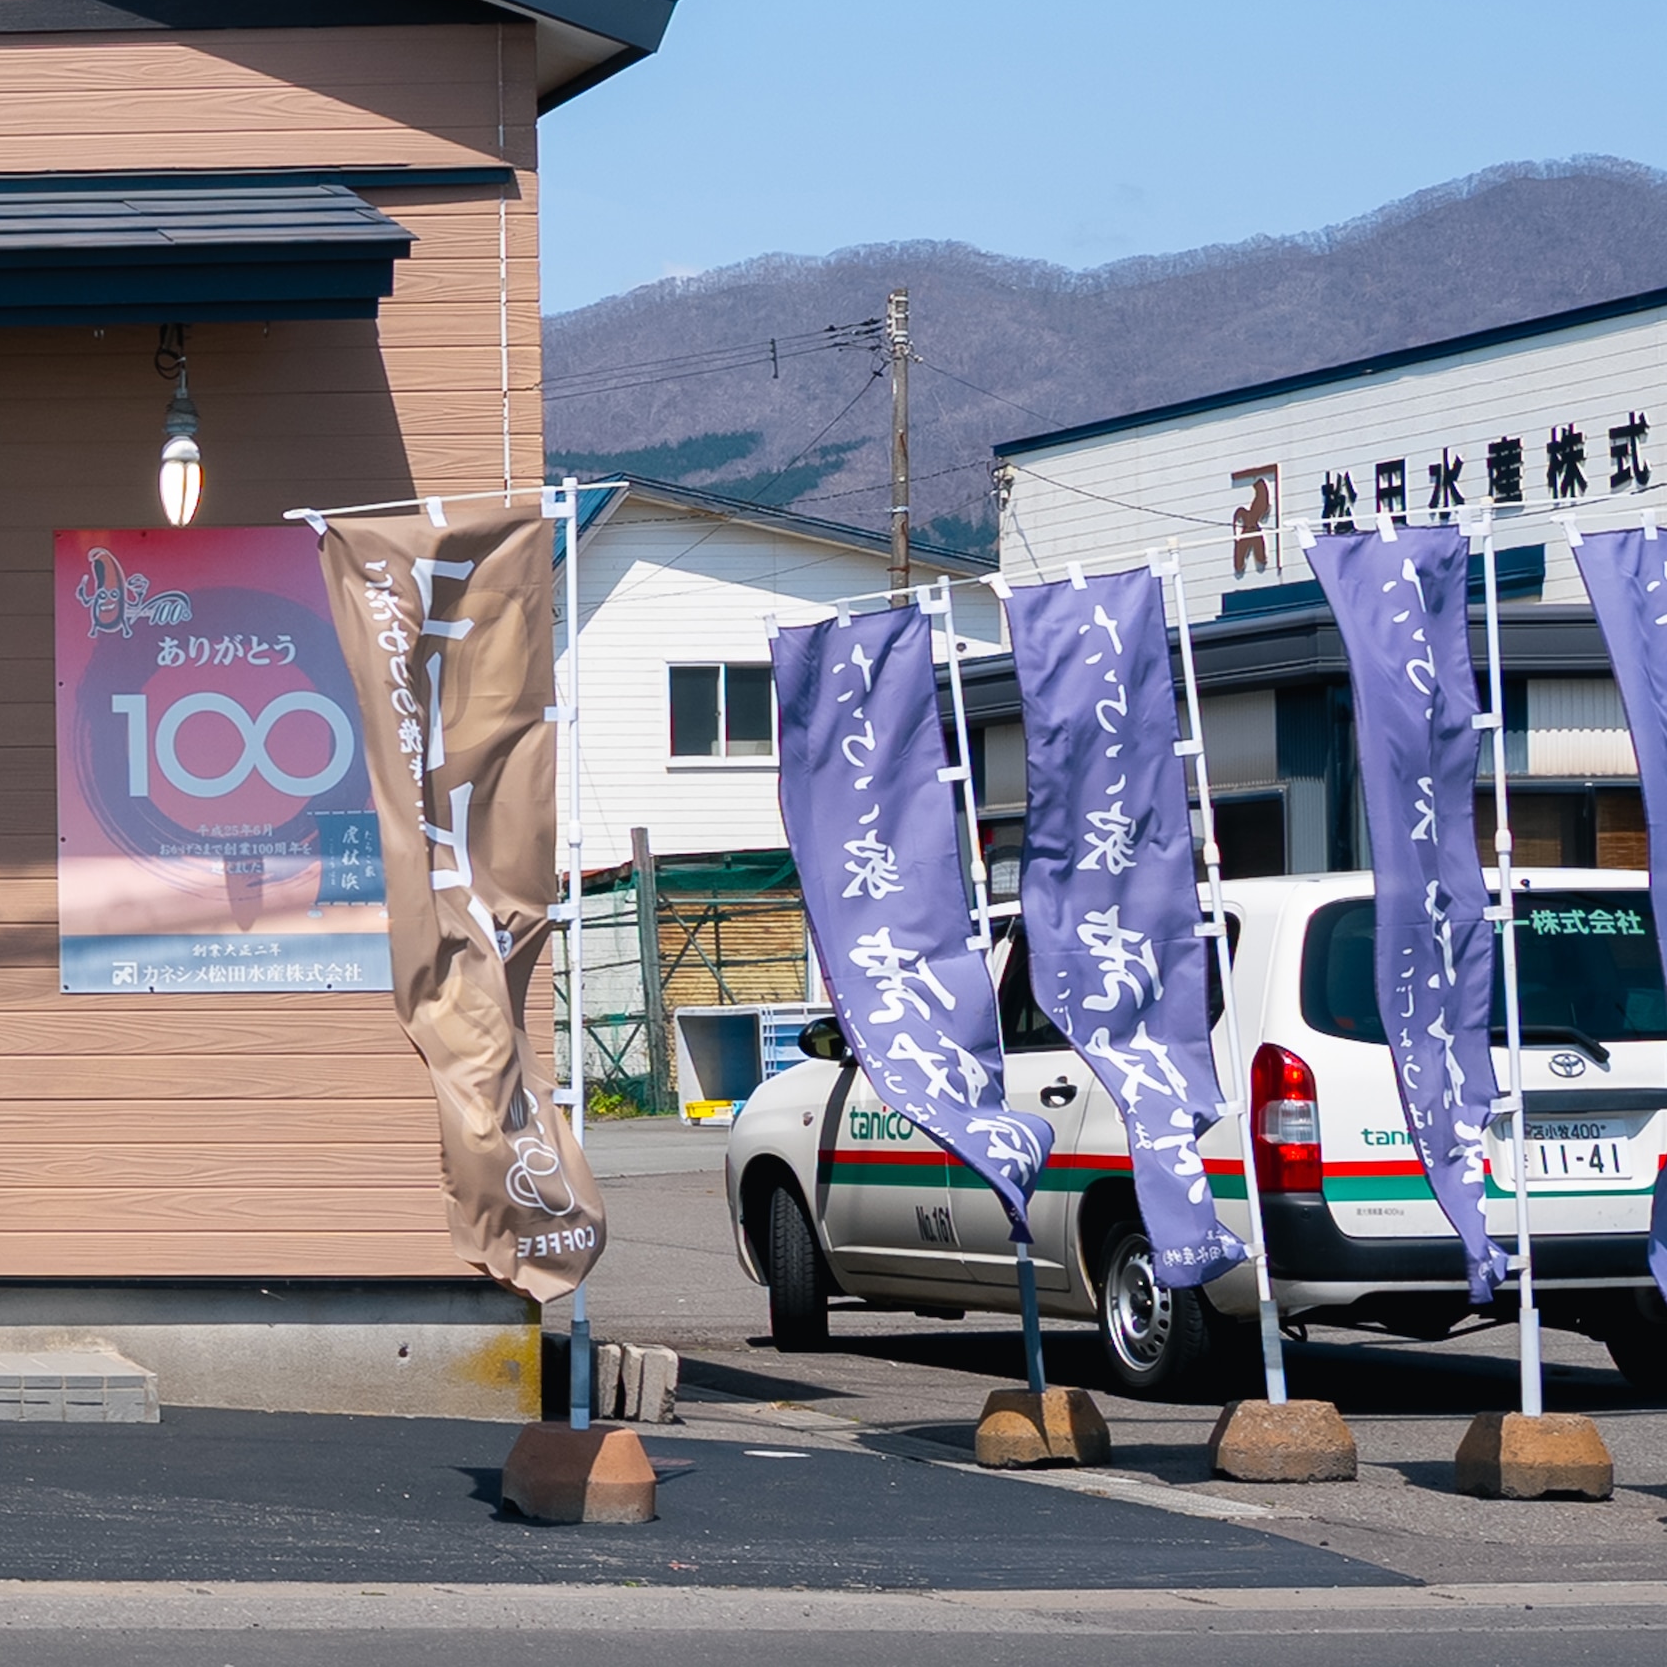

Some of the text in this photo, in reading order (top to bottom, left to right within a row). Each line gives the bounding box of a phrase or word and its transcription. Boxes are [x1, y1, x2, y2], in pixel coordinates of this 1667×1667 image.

[1321, 411, 1651, 534] 松田水産株式
[156, 635, 297, 667] ありがとう
[112, 691, 355, 798] 100
[196, 823, 273, 837] 平成25年6月
[159, 842, 312, 856] おかげさまで創業100周年を
[341, 825, 360, 890] 虎杖浜
[192, 943, 282, 957] 創業大正二年
[142, 963, 363, 983] カネシメ松田水産株式会社
[850, 1106, 914, 1140] tanico
[1540, 1143, 1621, 1174] 11-41
